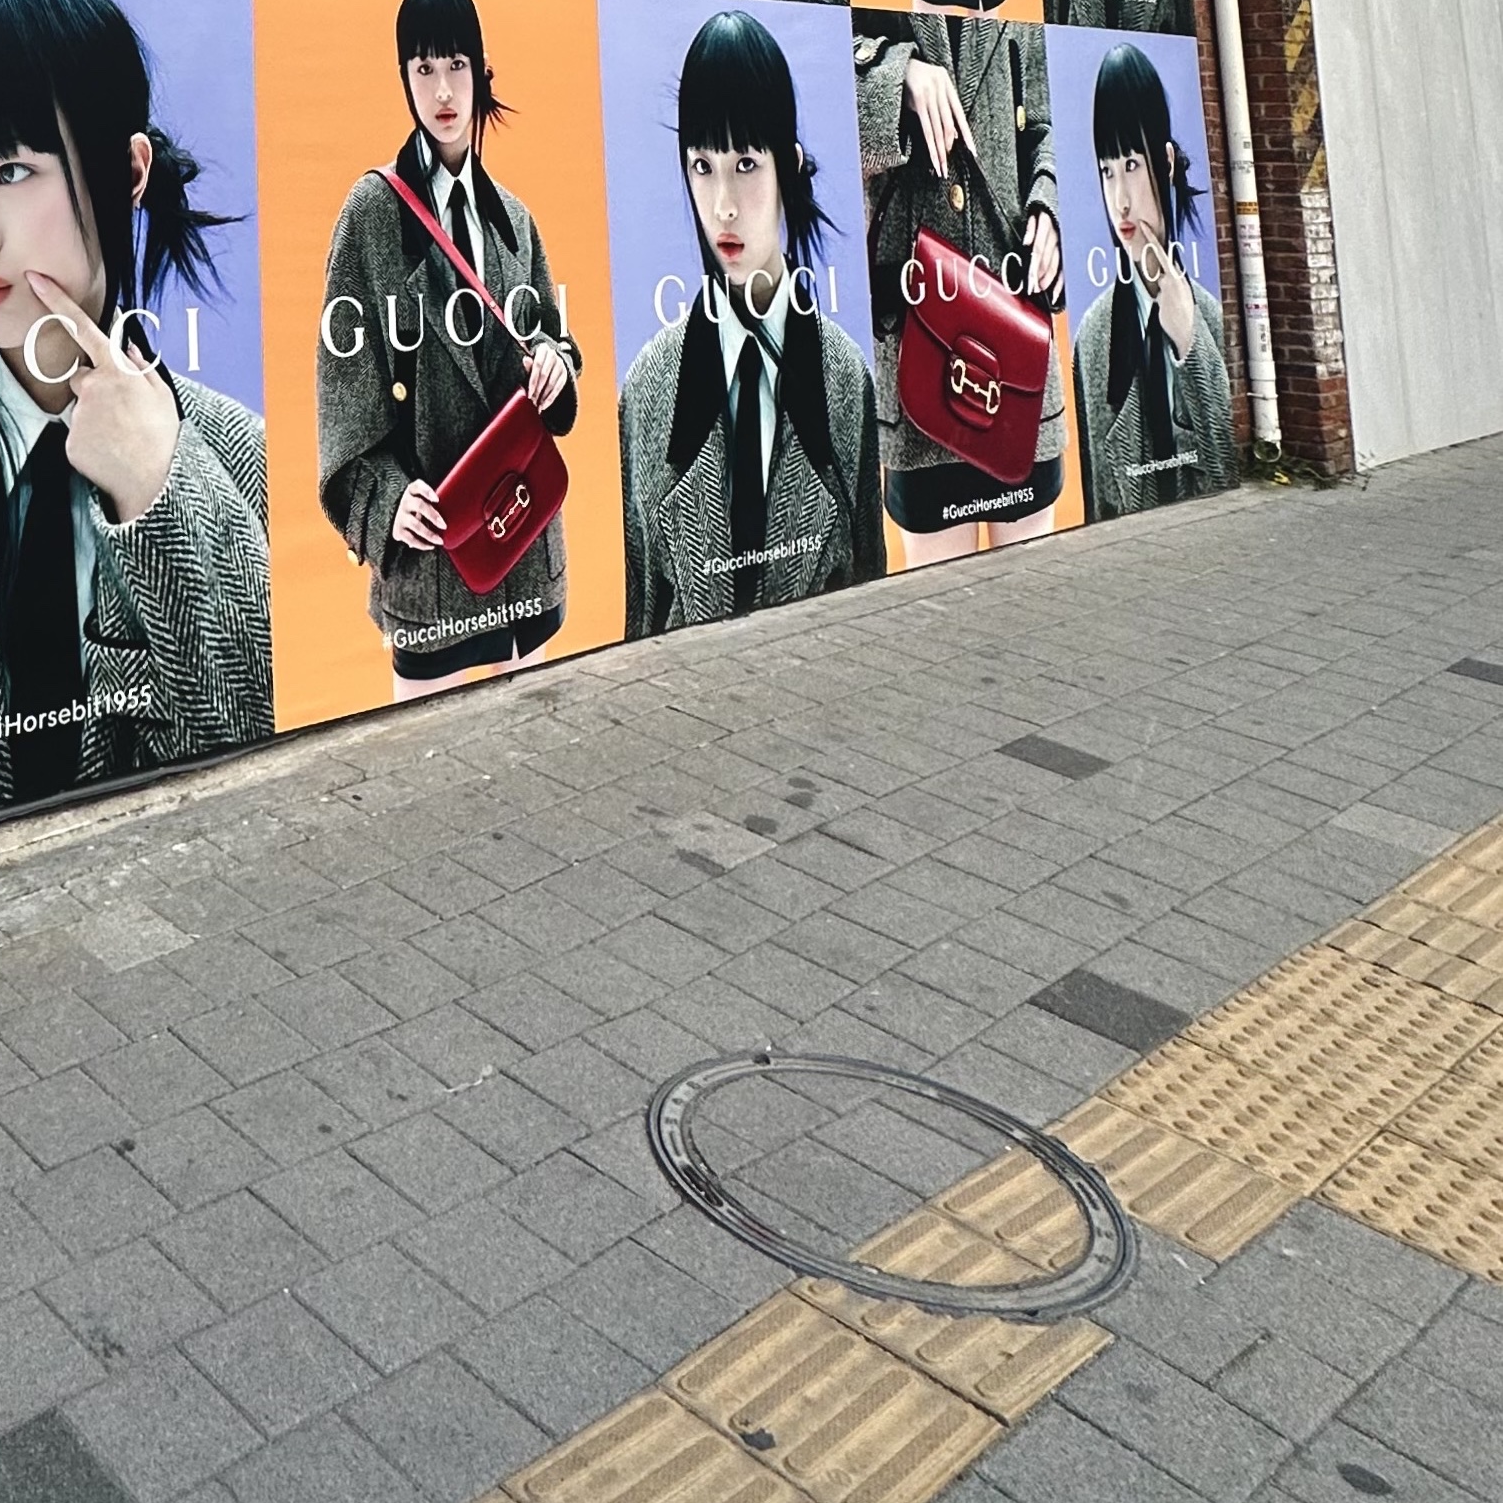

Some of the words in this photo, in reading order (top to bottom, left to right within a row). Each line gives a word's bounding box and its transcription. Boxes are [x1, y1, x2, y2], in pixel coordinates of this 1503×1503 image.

[900, 252, 1042, 306] GUCCI
[1087, 241, 1200, 287] GUCCI
[654, 265, 839, 329] GUCCI
[942, 487, 1034, 521] #GucciHorsebit1955
[703, 534, 823, 576] #GucciHorsebit1955
[381, 597, 542, 651] #GucciHorsebit1955
